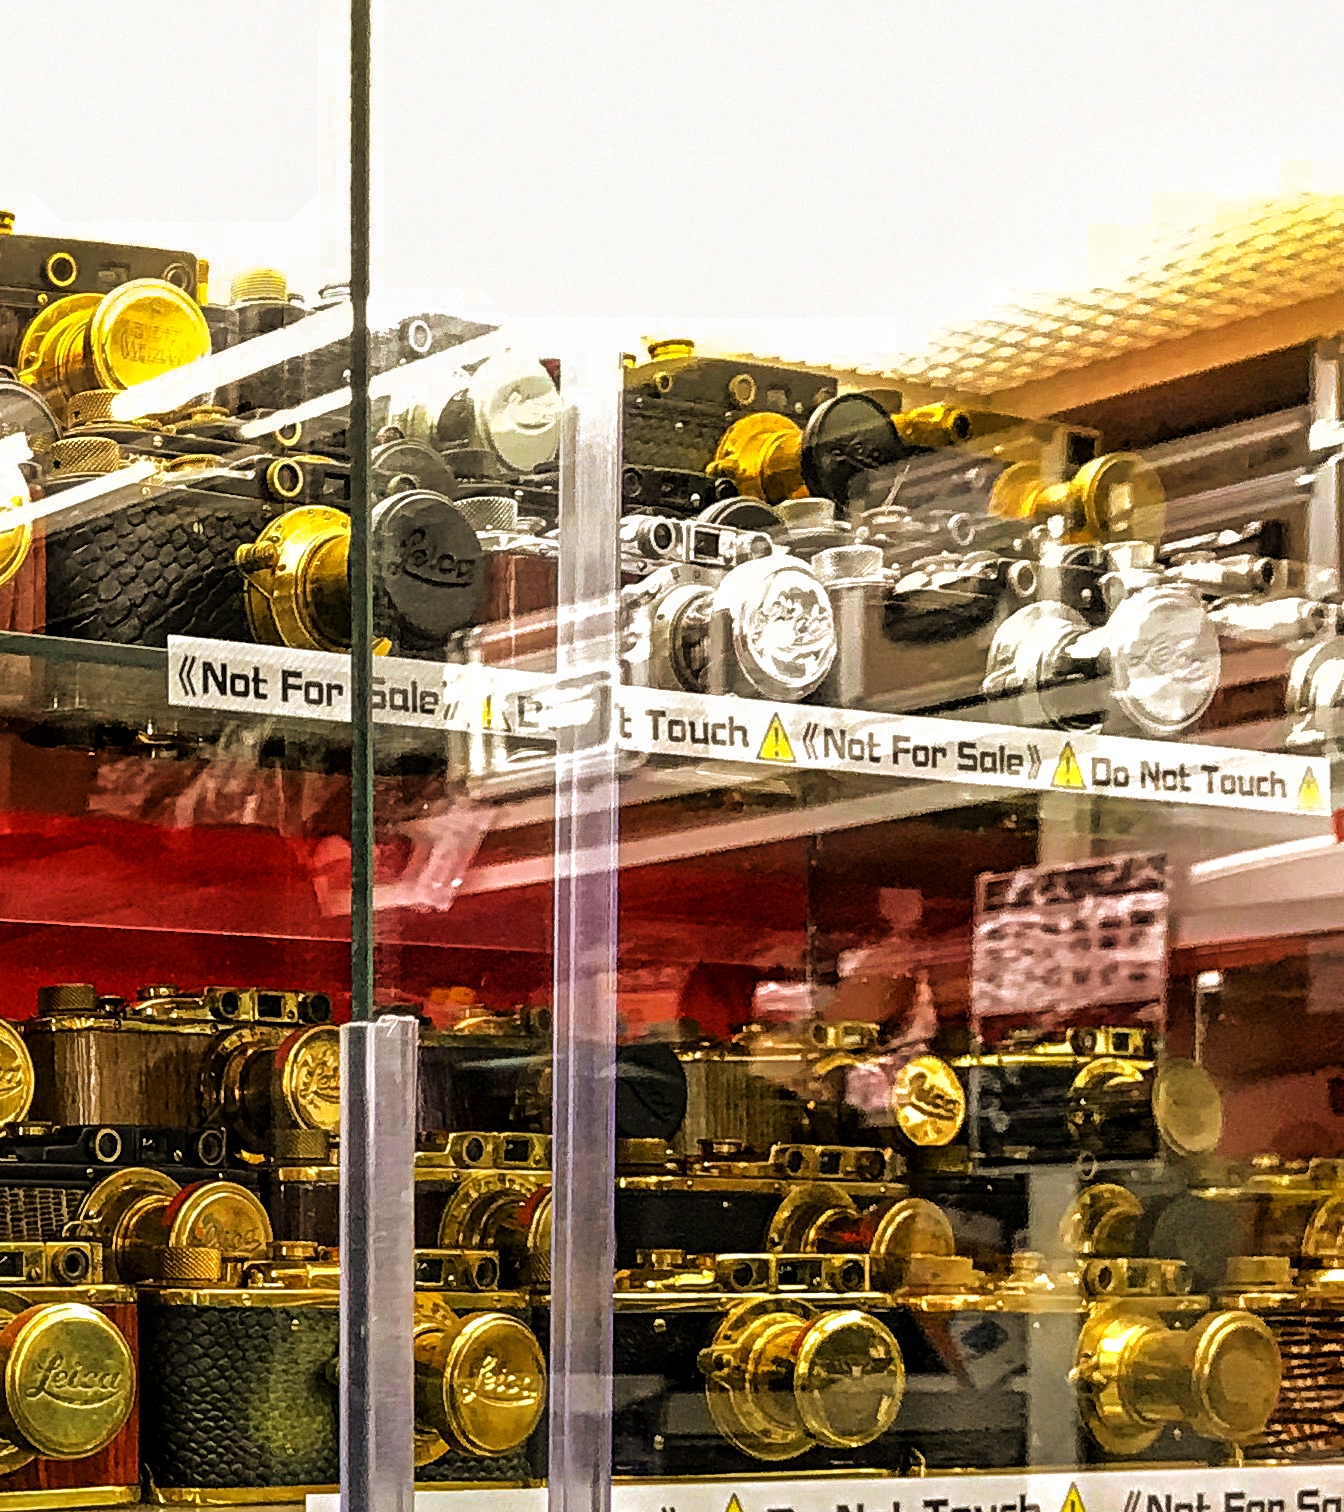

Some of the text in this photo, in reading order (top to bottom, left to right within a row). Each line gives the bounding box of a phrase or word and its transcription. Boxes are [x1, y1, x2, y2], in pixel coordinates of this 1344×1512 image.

[280, 669, 344, 708] For
[645, 707, 749, 749] Touch
[892, 737, 949, 770] For
[1090, 756, 1130, 789] Do
[1140, 760, 1193, 792] Not
[1199, 764, 1288, 798] Touch
[25, 1346, 126, 1411] Leica
